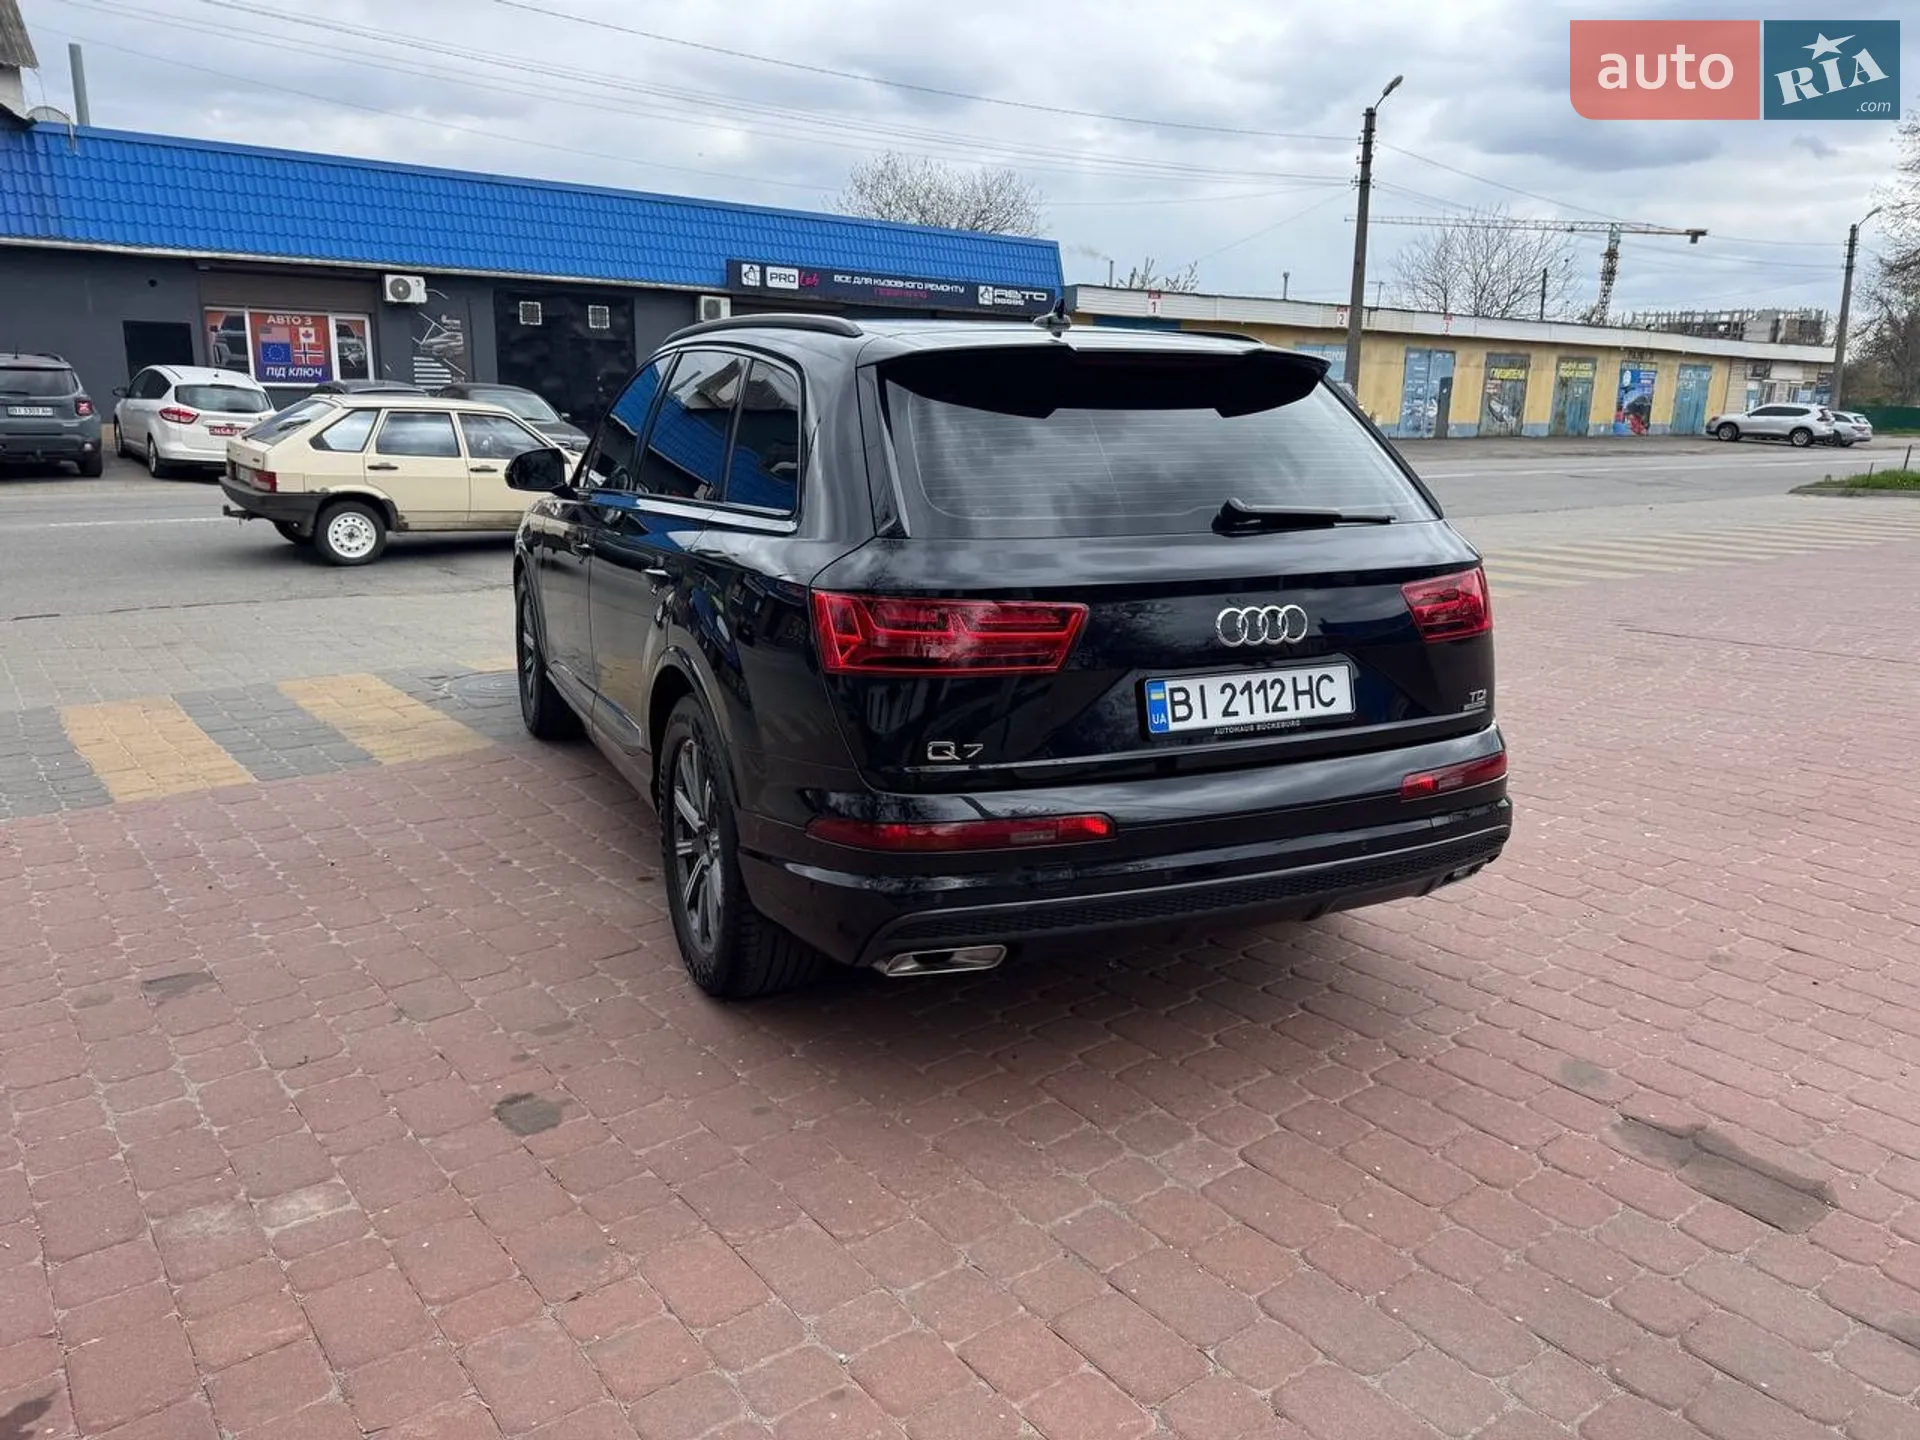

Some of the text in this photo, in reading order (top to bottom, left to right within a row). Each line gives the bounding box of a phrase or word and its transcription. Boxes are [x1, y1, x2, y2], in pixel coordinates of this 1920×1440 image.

[769, 272, 797, 284] PRO
[266, 315, 301, 325] АВТО
[265, 366, 323, 378] ПІД КЛЮЧ
[1168, 673, 1337, 723] BI 2112 HC
[1151, 712, 1168, 725] UA
[1213, 725, 1255, 736] AUTOHAUS
